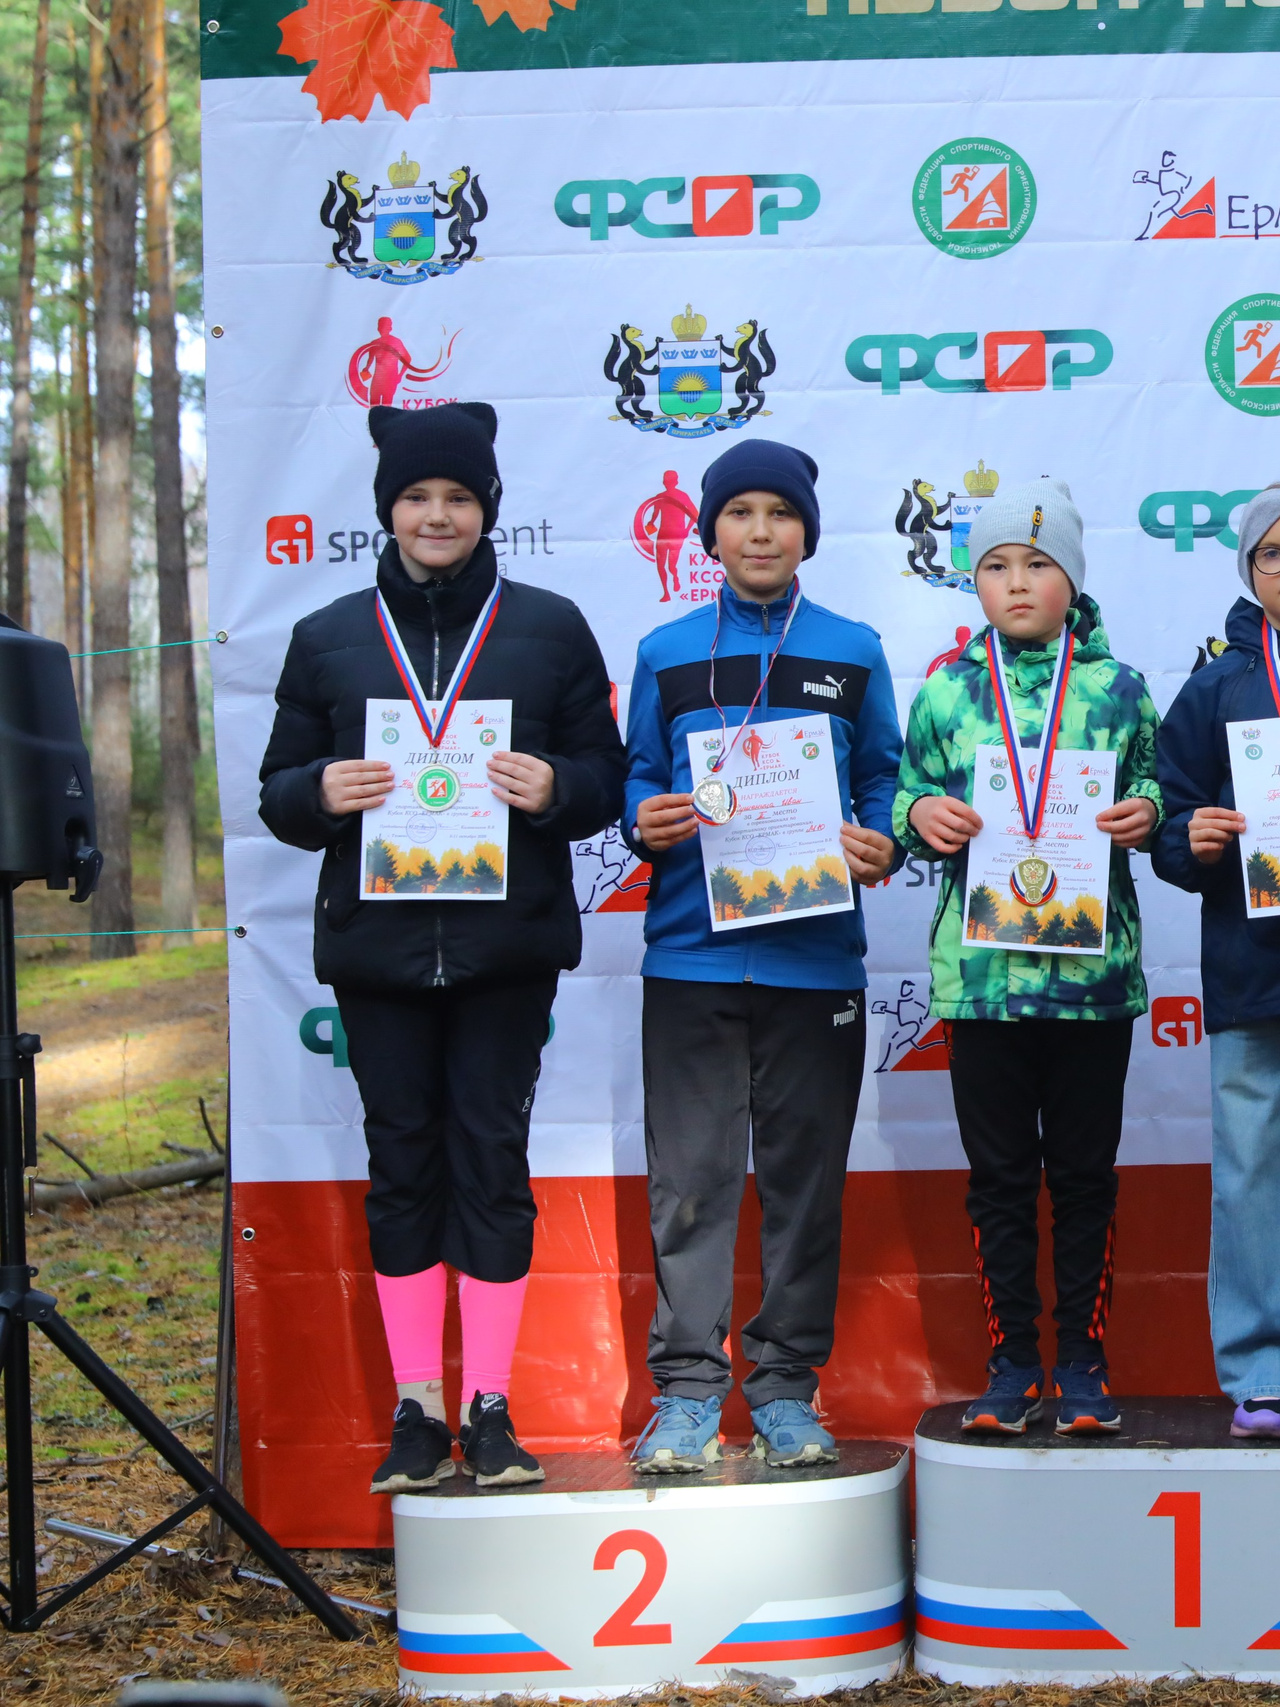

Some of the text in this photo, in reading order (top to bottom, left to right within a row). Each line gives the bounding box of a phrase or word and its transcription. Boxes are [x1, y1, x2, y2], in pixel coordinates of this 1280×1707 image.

[919, 143, 1031, 254] ФЕДЕРАЦИЯ СПОРТИВНОГО ОРИЕНТИРОВАНИЯ ТЮМЕНСКОЙ ОБЛАСТИ
[1211, 310, 1239, 357] ФЕДЕРАЦИЯ
[1212, 362, 1236, 398] ОБЛАСТИ
[689, 571, 726, 583] КСО
[803, 681, 838, 700] PUMA
[404, 753, 475, 765] ДИПЛОМ
[733, 768, 800, 789] ДИПЛОМ
[741, 788, 797, 801] НАГРАЖДАЕТСЯ
[772, 808, 797, 817] место
[834, 1009, 855, 1026] PUMA
[1147, 1492, 1201, 1627] 1
[593, 1529, 671, 1646] 2
